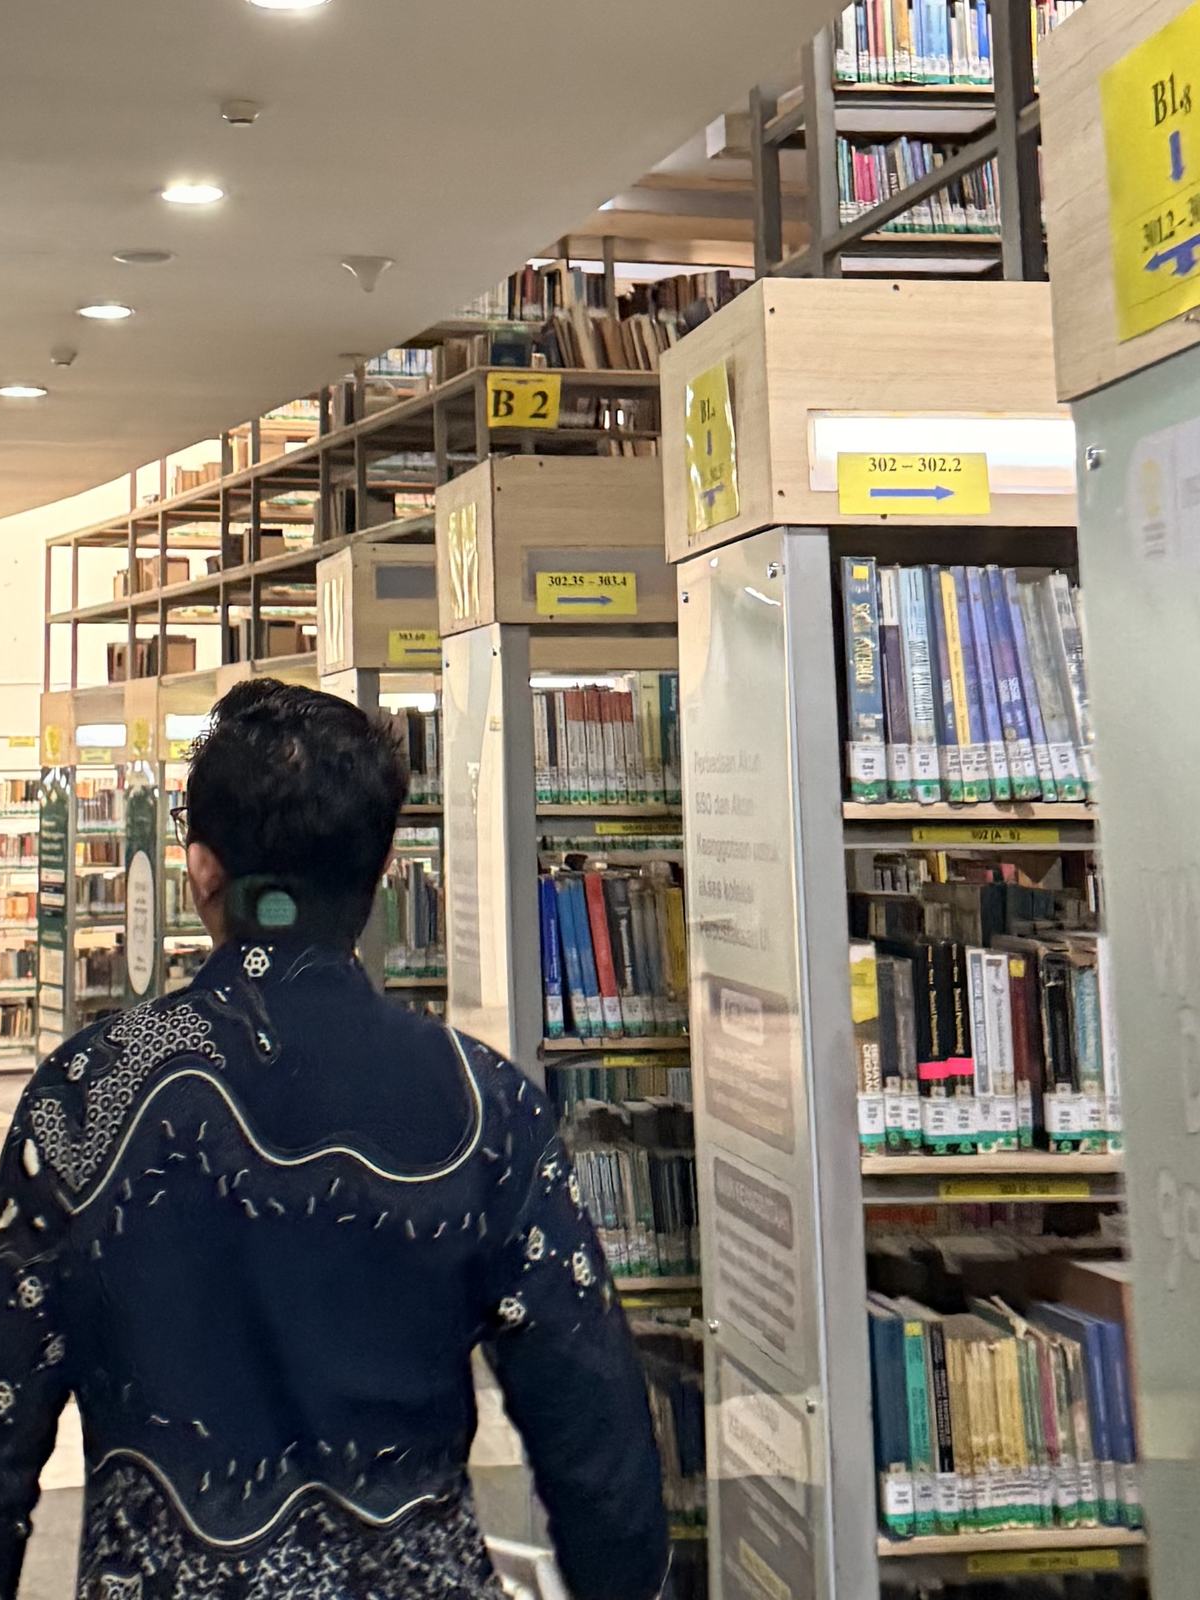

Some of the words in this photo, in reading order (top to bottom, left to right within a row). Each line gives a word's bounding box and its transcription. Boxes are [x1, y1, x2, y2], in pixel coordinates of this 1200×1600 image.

[492, 389, 515, 418] B
[530, 390, 550, 419] 2
[868, 457, 897, 472] 302
[918, 457, 962, 472] 302.2
[547, 575, 585, 587] 302.35
[598, 575, 628, 587] 303.4
